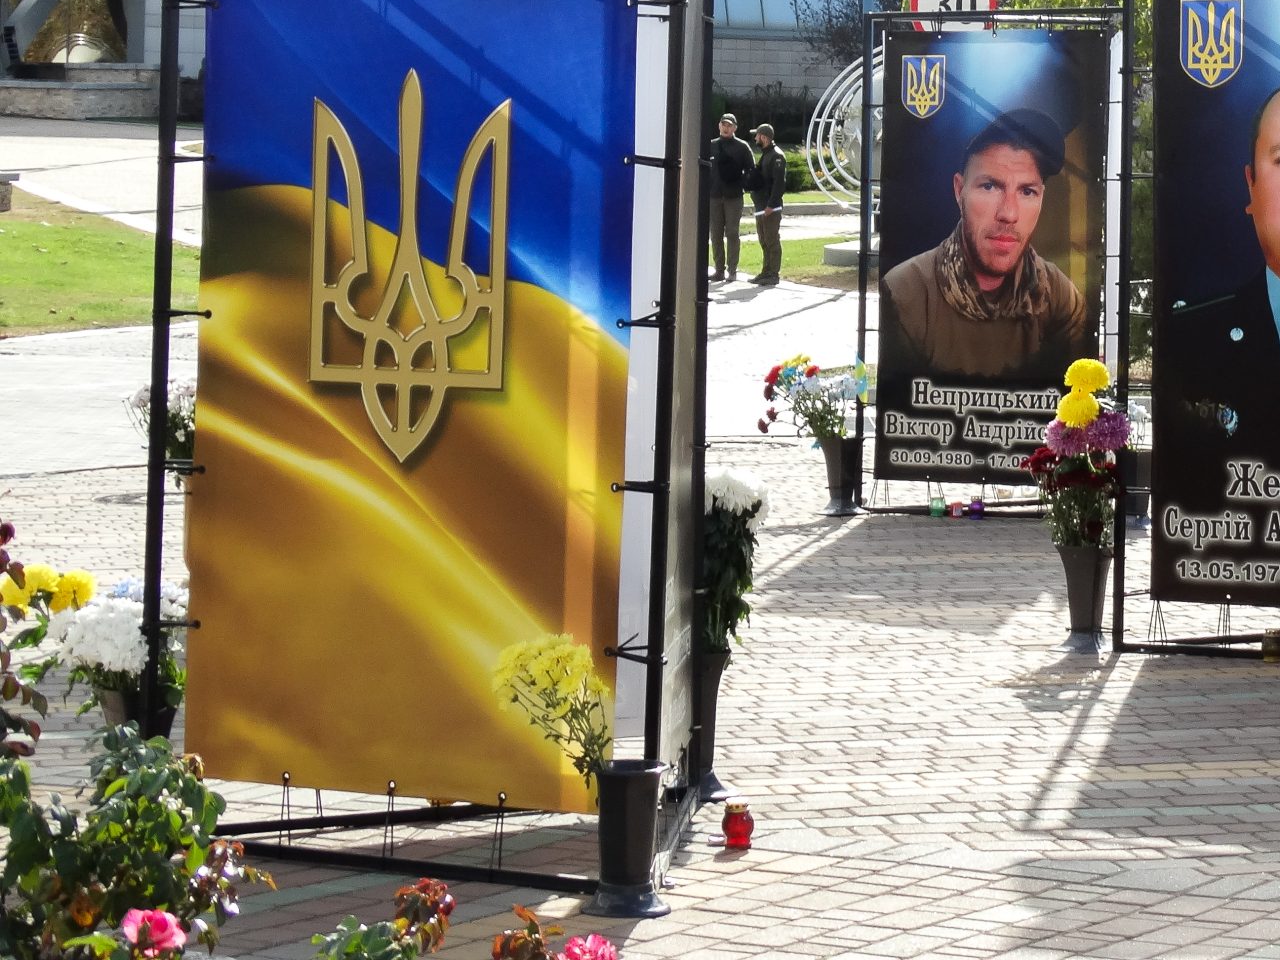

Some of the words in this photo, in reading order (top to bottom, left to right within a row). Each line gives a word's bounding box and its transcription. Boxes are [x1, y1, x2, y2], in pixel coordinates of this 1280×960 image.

[911, 379, 1061, 415] Неприцький
[885, 413, 954, 444] Віктор
[963, 416, 1047, 446] Андрійо
[891, 450, 973, 466] 30.09.1980
[1164, 507, 1251, 548] Сергій
